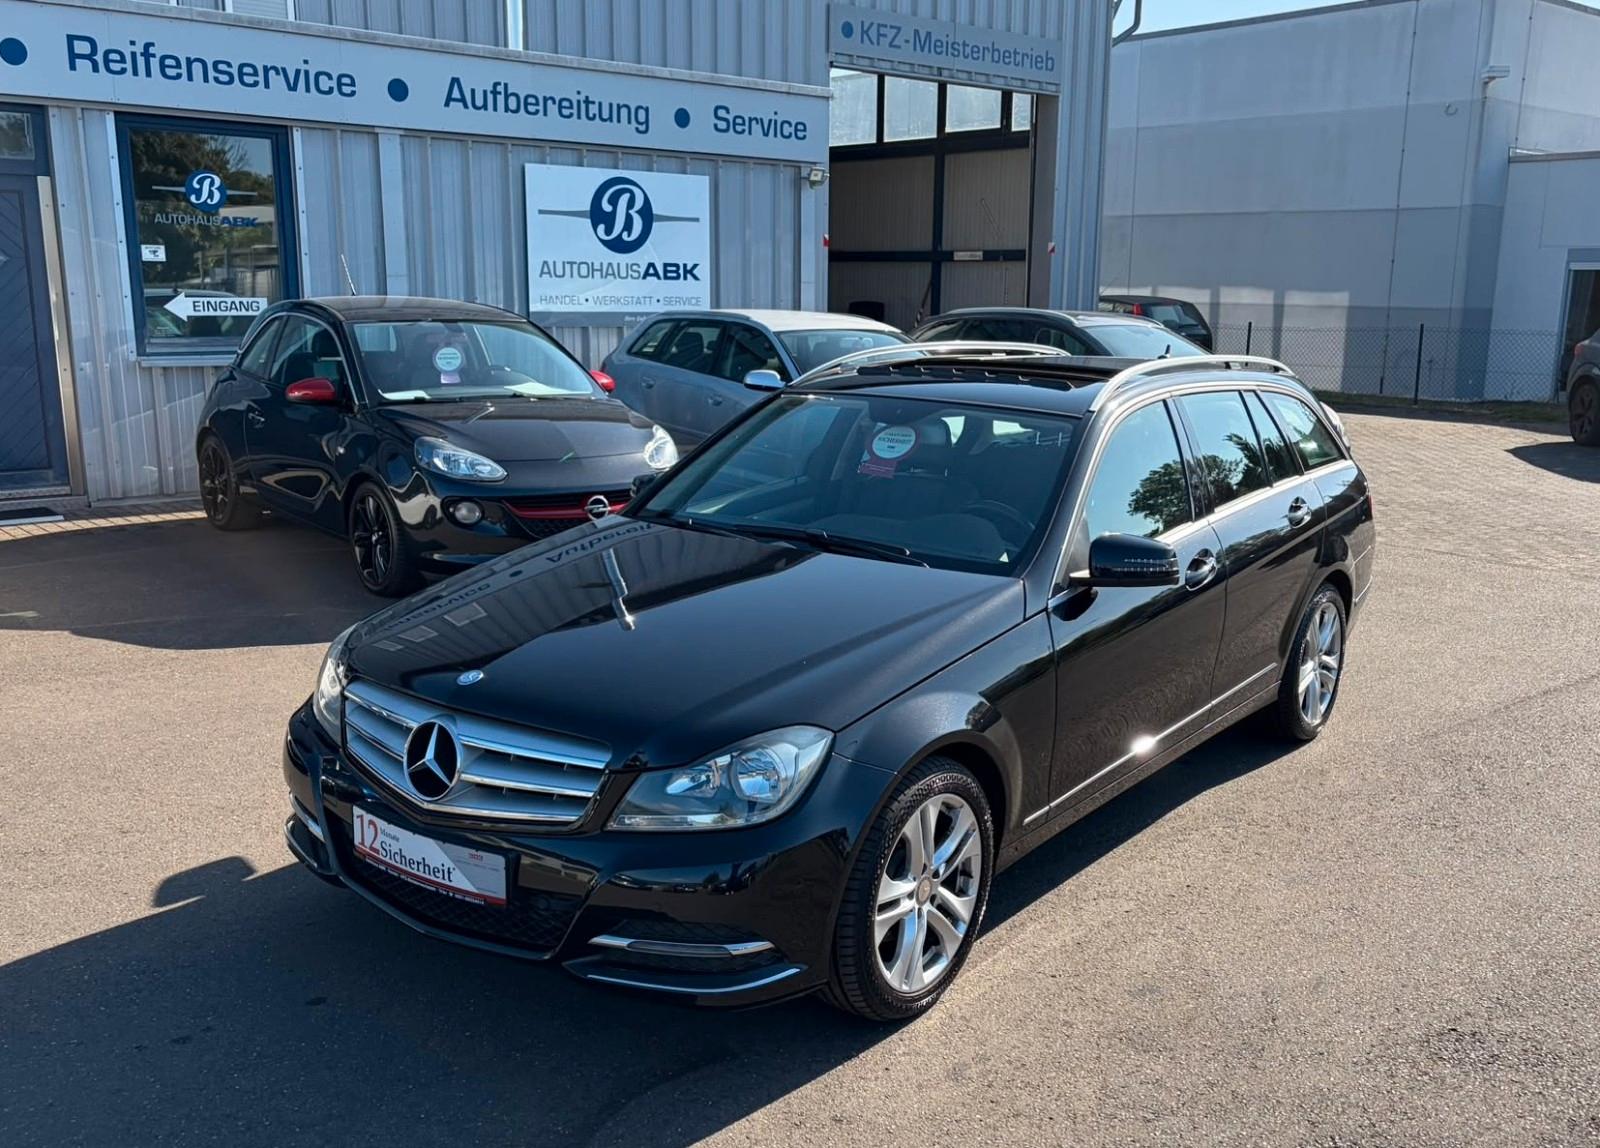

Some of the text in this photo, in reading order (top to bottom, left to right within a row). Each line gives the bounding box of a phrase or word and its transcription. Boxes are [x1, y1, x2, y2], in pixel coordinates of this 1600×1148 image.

[66, 33, 357, 98] Reifenservice
[859, 19, 1055, 72] KFZ-Meisterbetrieb
[444, 76, 650, 135] Aufbereitung
[713, 105, 808, 140] Service
[192, 300, 260, 313] EINGANG
[539, 295, 702, 307] HANDEL WERKSTATT SERVICE
[356, 814, 380, 856] 12
[380, 840, 453, 883] Sicherheit
